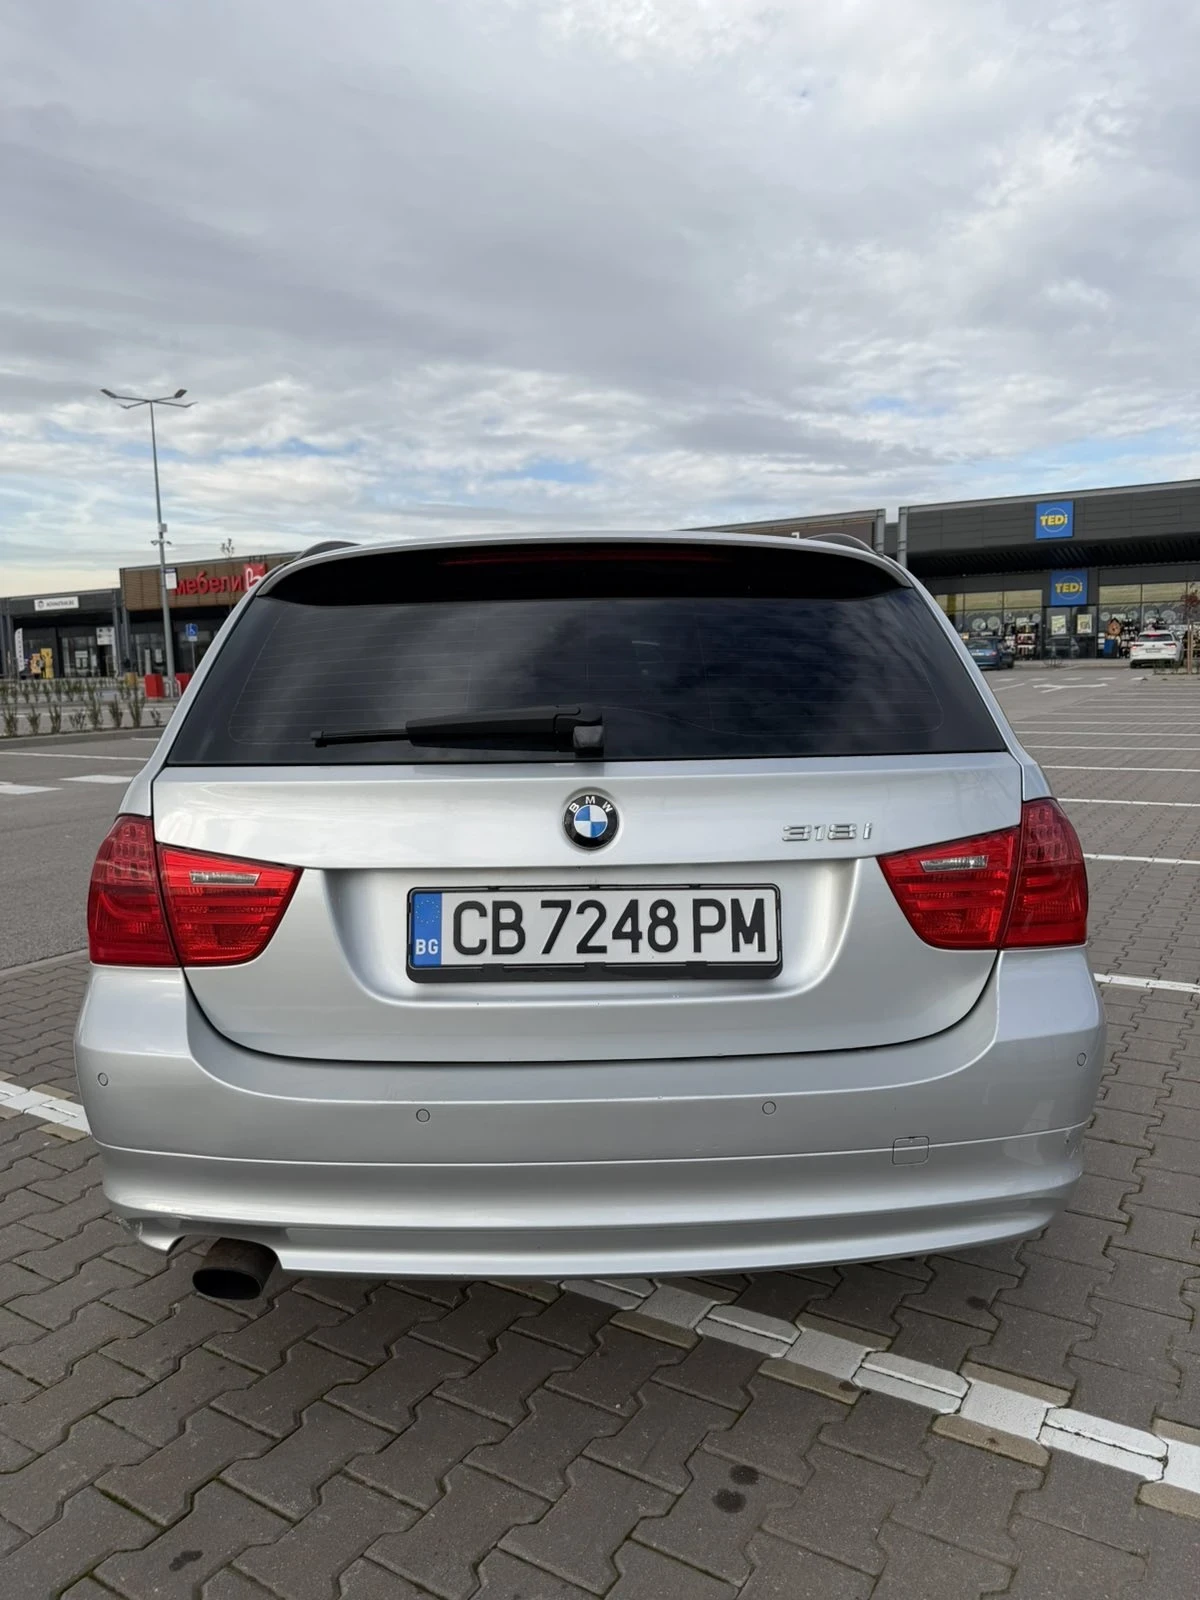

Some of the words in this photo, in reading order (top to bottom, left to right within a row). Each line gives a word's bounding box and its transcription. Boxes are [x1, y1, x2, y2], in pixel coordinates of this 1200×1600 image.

[1040, 514, 1068, 526] TEDi
[174, 571, 245, 595] мебели
[1055, 582, 1083, 594] TEDi
[568, 795, 613, 814] BMW
[453, 900, 526, 955] CB
[540, 898, 679, 955] 7248
[692, 898, 766, 953] PM
[415, 939, 439, 955] BG
